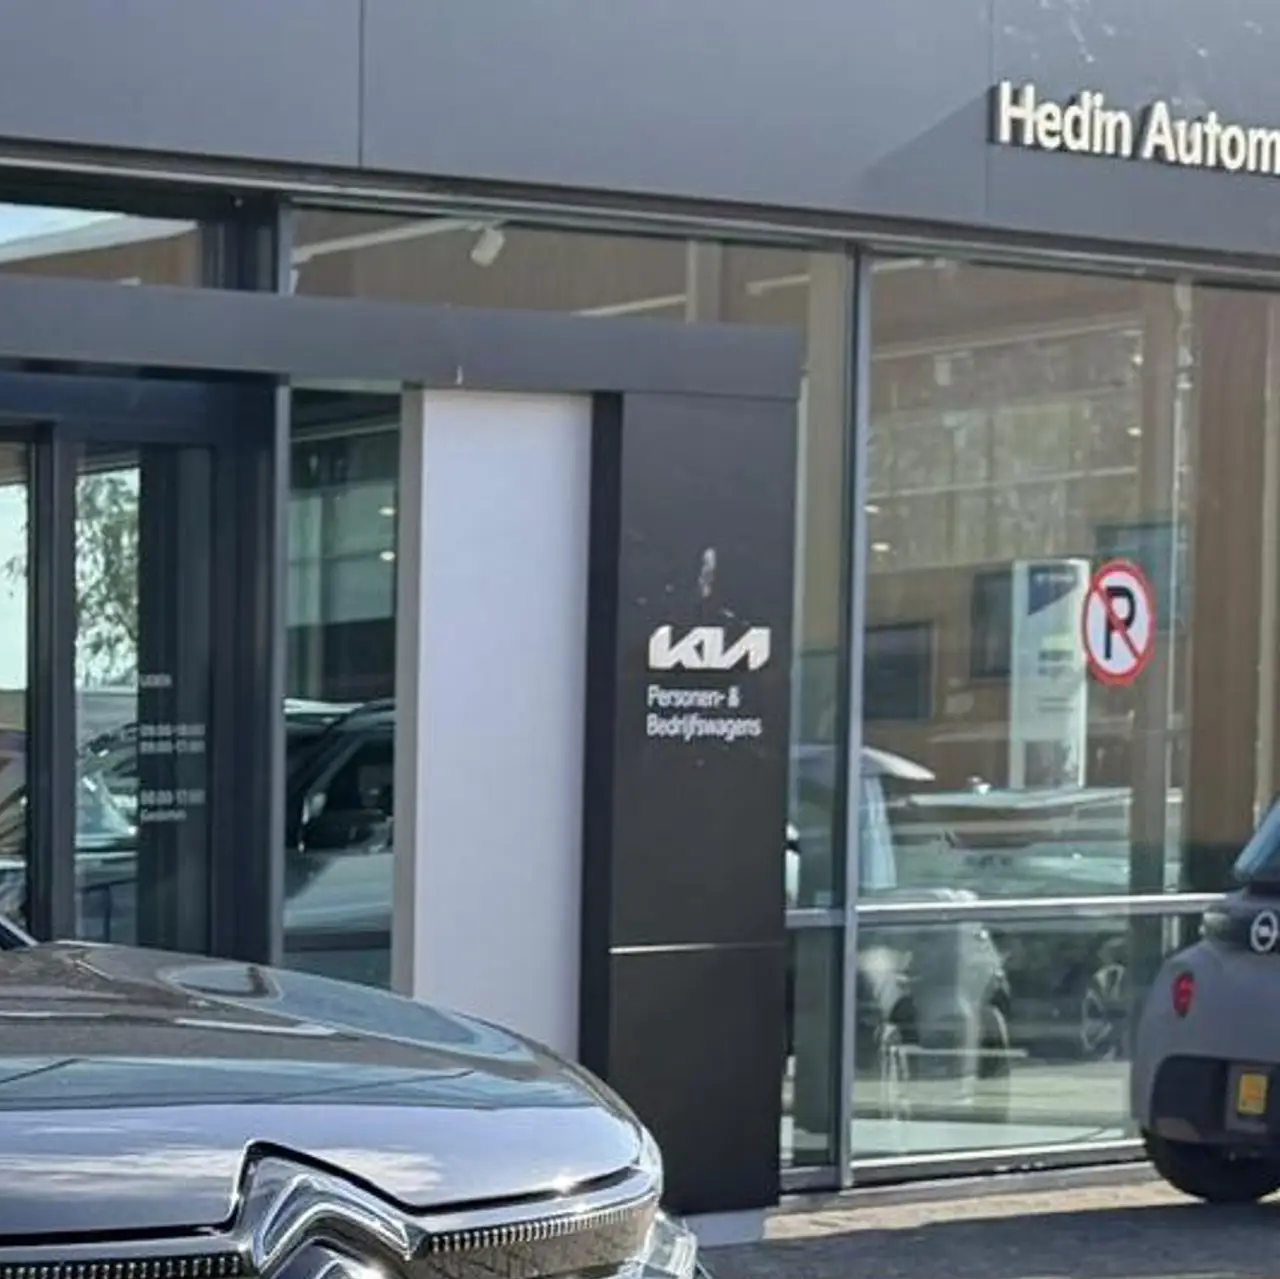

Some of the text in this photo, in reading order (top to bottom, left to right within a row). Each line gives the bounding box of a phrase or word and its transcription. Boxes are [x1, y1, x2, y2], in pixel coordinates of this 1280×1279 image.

[999, 81, 1280, 174] Hedin Autom
[649, 625, 771, 671] KIA
